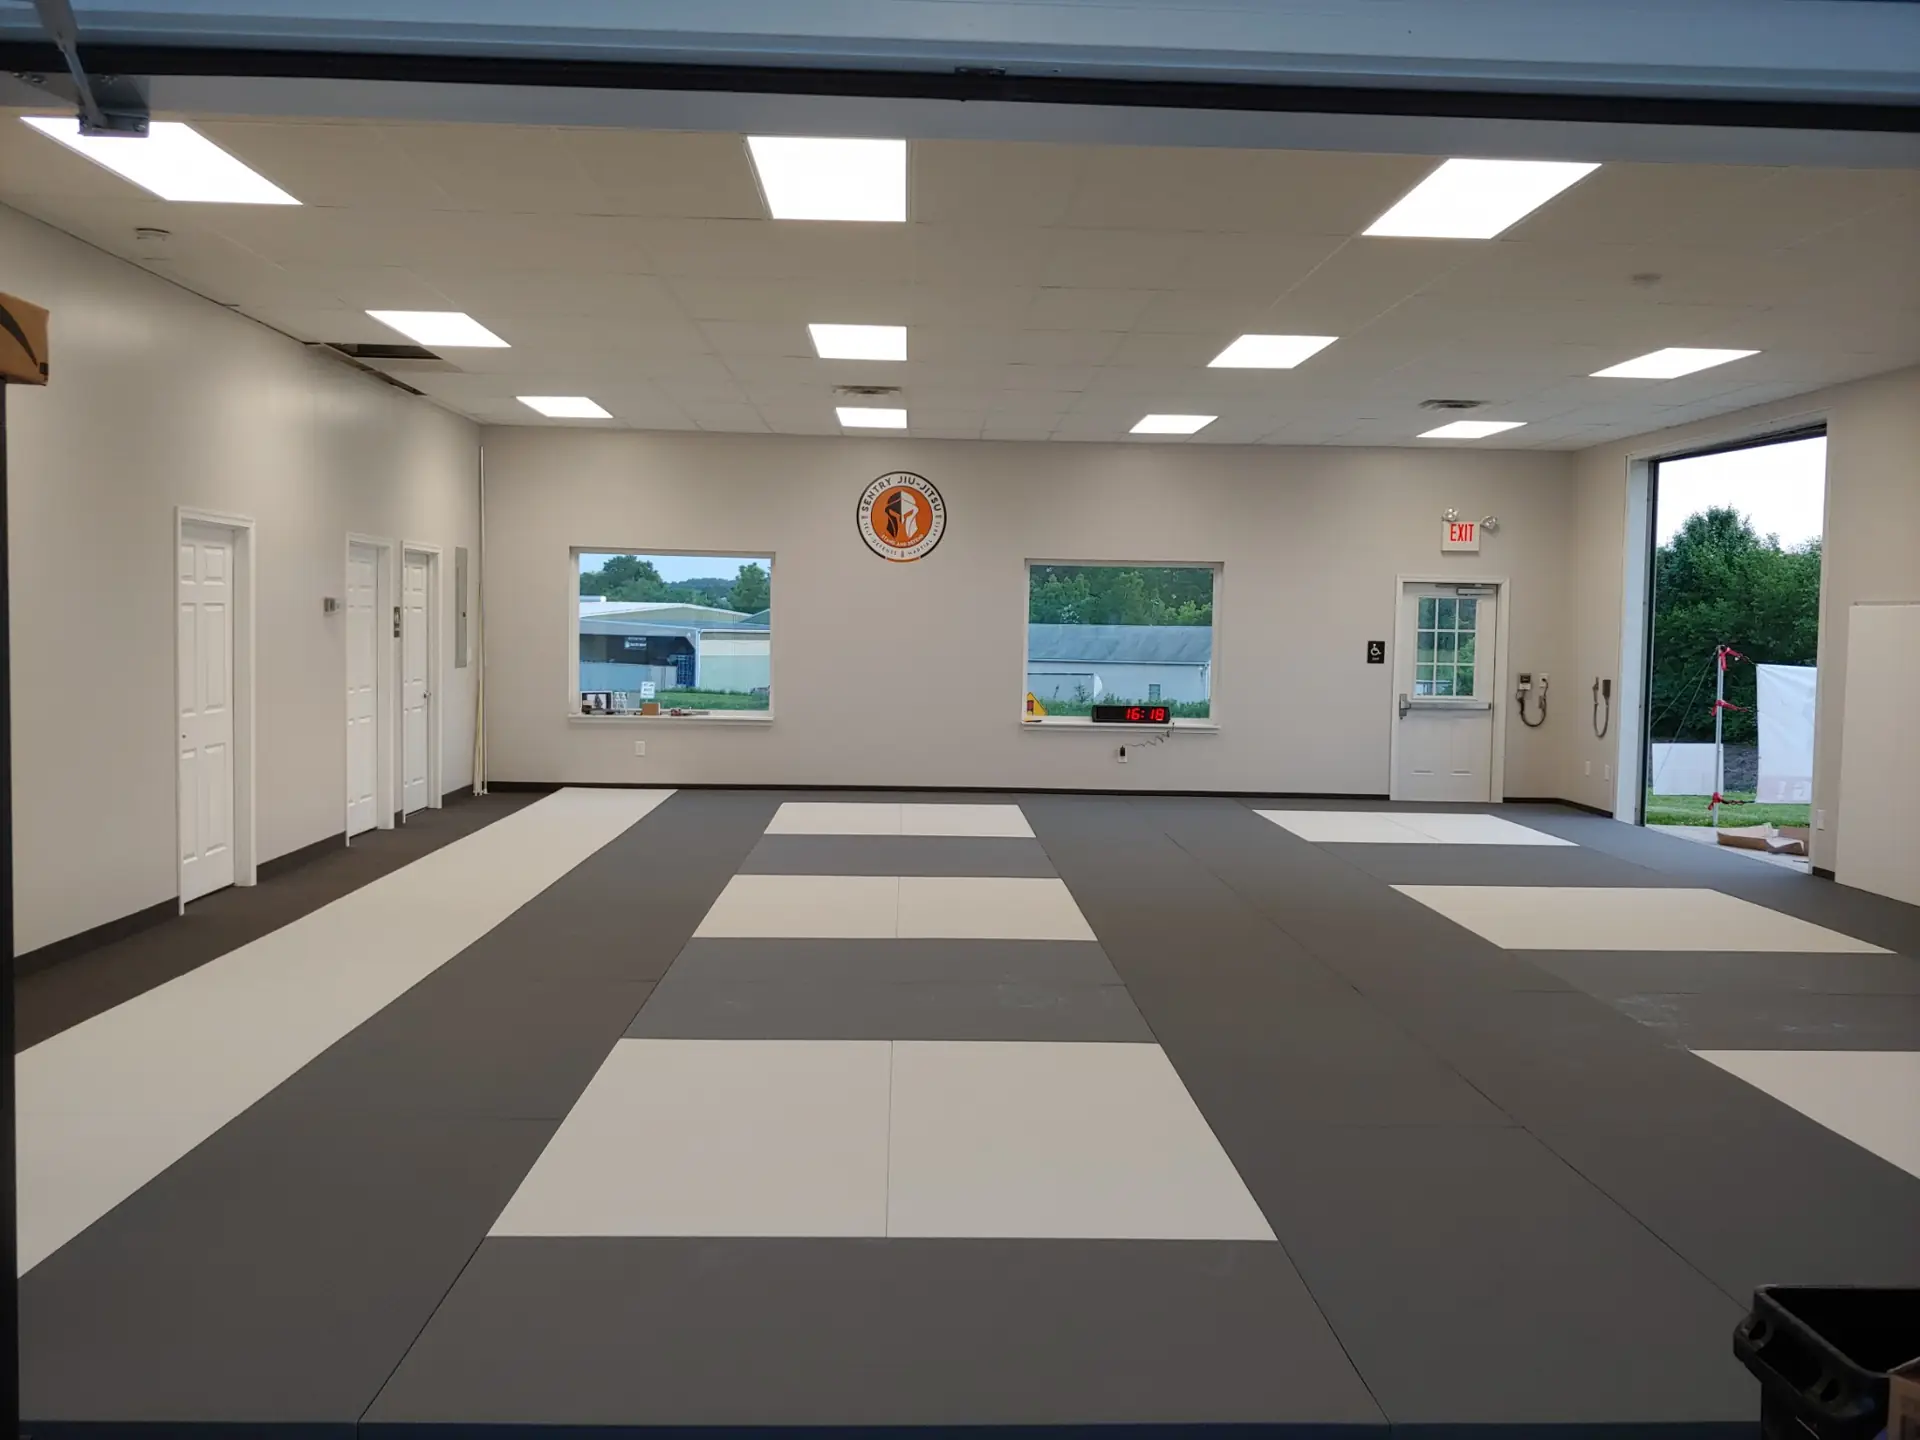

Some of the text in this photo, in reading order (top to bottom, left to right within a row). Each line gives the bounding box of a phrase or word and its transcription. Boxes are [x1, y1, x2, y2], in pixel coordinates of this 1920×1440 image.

[861, 476, 942, 512] SENTRY JIU-JITSU
[1450, 523, 1475, 542] EXIT
